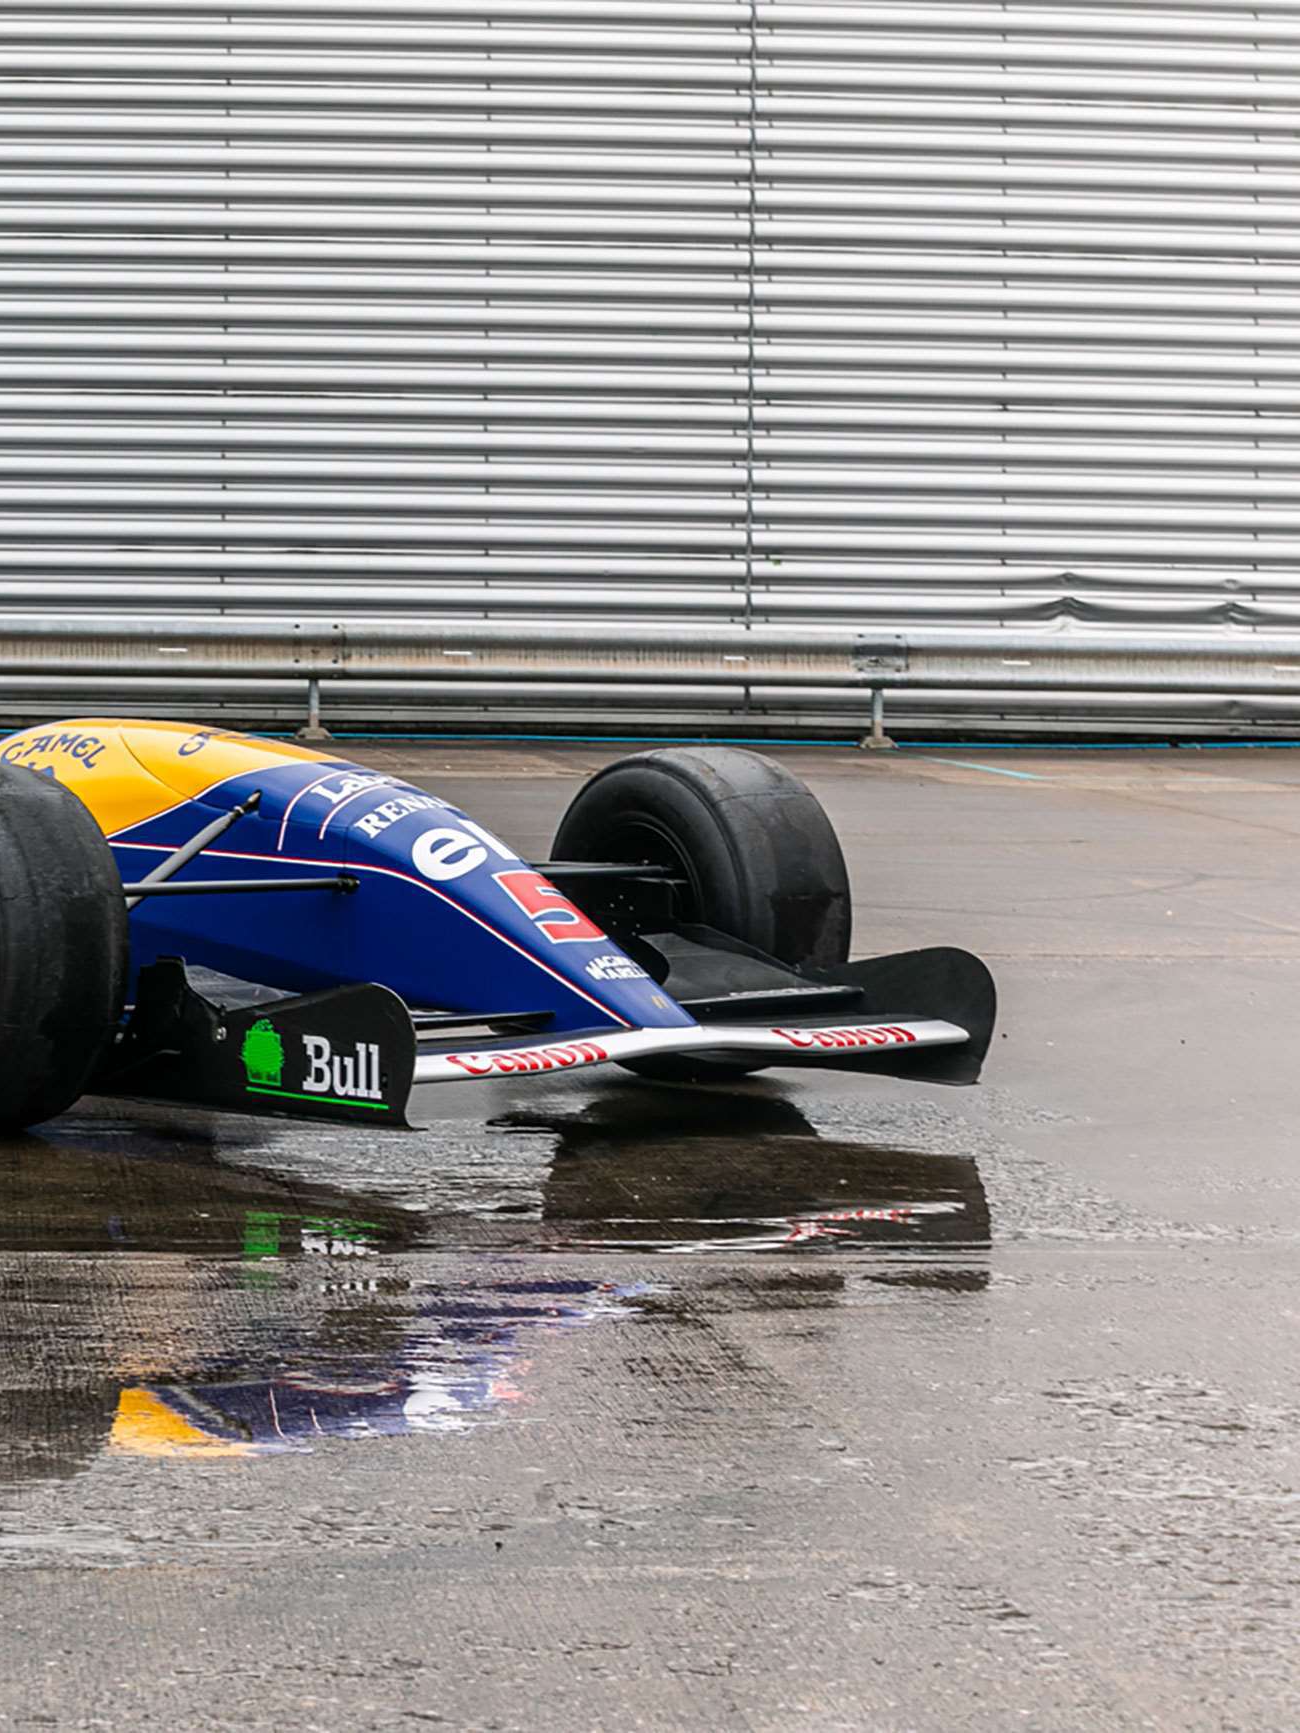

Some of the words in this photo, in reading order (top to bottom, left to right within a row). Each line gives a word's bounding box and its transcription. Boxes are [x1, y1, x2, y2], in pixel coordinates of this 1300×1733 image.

[0, 733, 107, 768] CAMEL
[412, 819, 519, 881] el
[491, 870, 608, 944] 5
[446, 1042, 608, 1075] Canon
[772, 1024, 917, 1048] Canon
[302, 1034, 383, 1100] Bull
